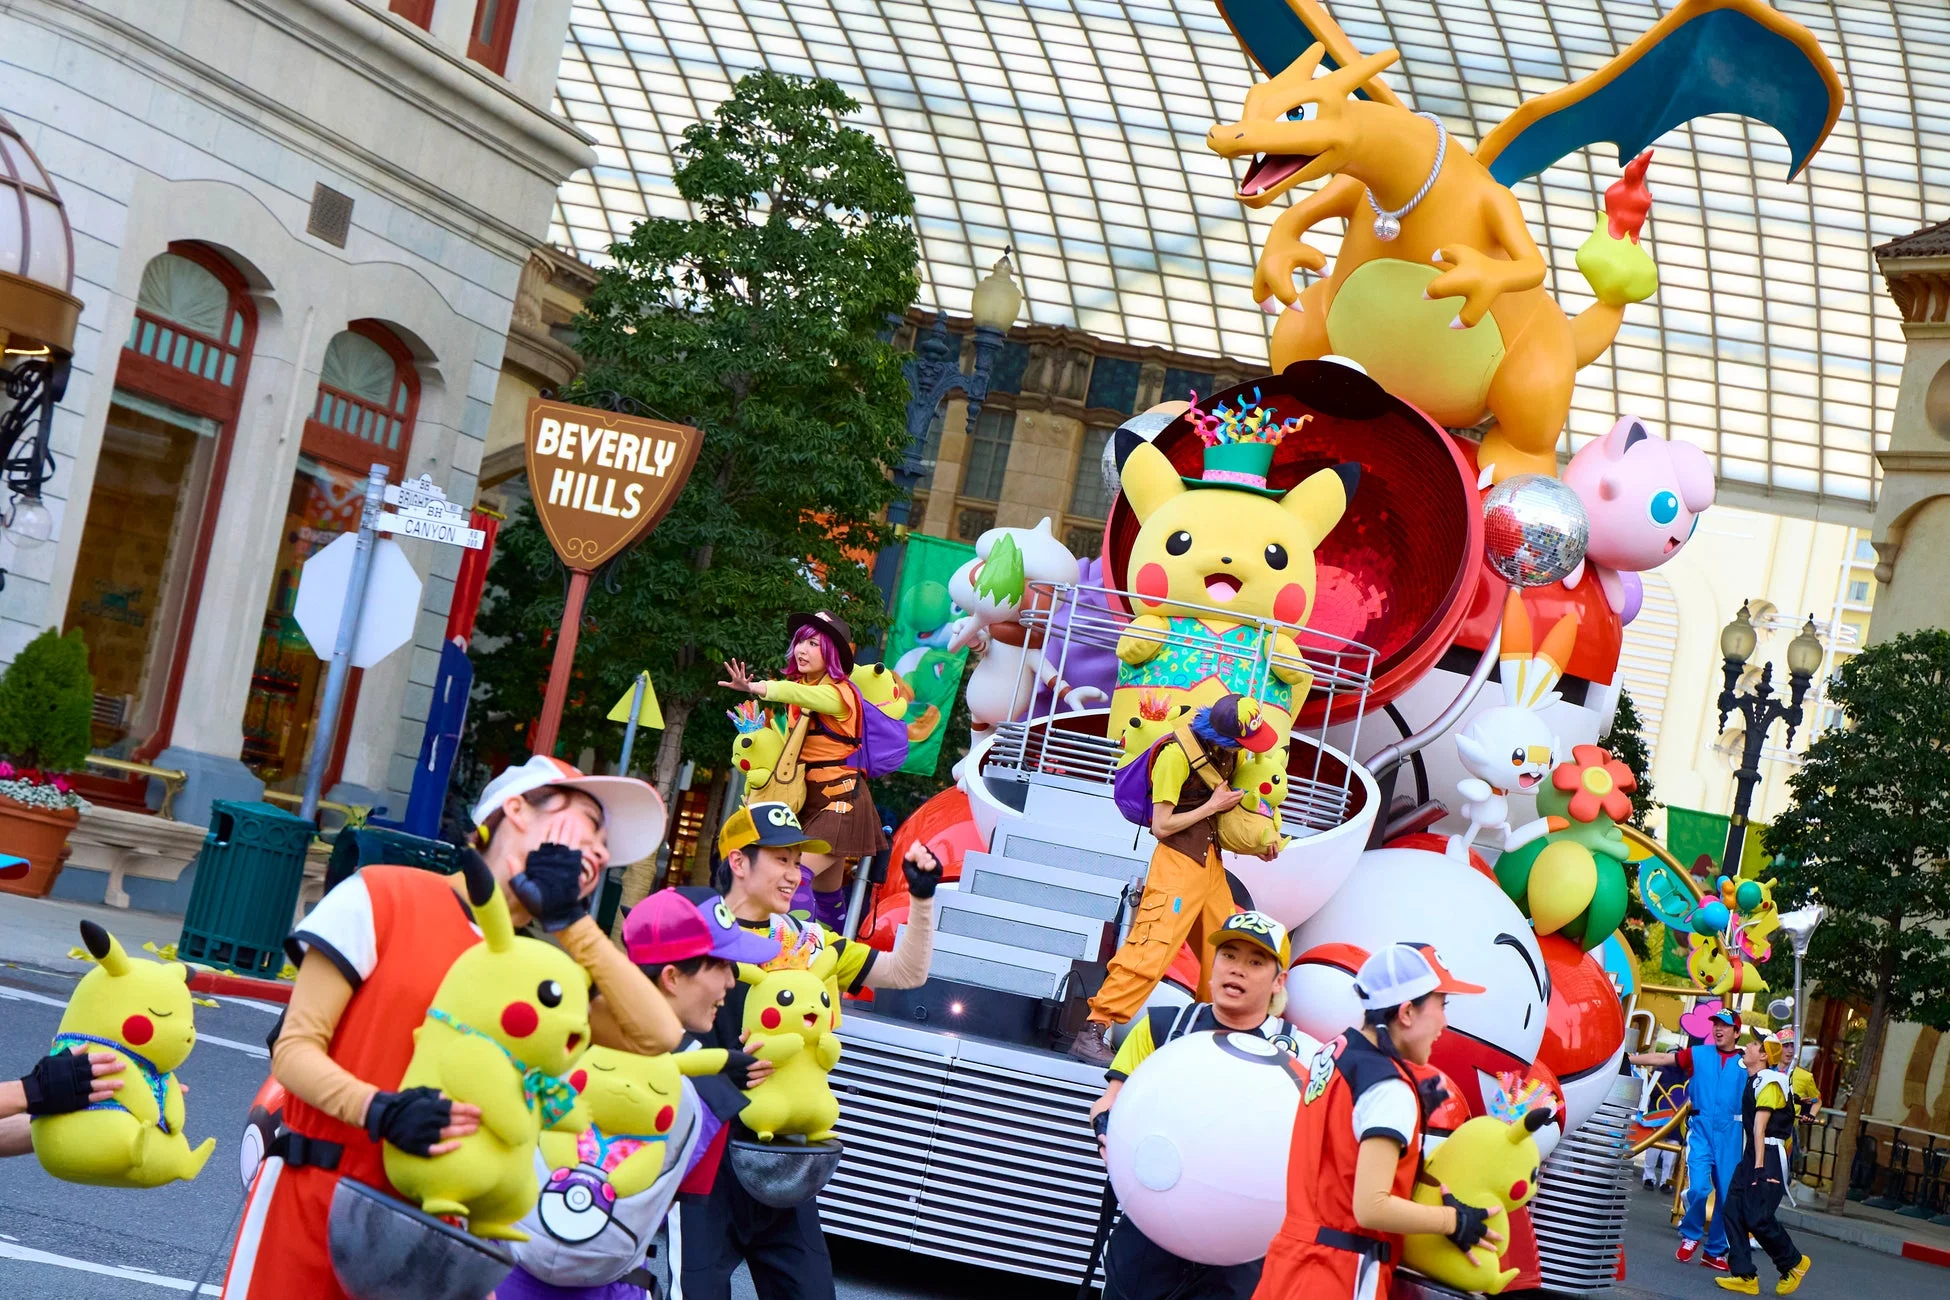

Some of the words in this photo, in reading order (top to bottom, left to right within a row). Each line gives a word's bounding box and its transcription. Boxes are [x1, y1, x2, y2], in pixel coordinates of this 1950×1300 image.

[535, 417, 677, 478] BEVERLY
[398, 490, 435, 506] BRIGHT
[548, 467, 644, 519] HILLS
[427, 506, 443, 518] BH
[405, 519, 456, 542] CANYON
[1228, 913, 1276, 935] 025
